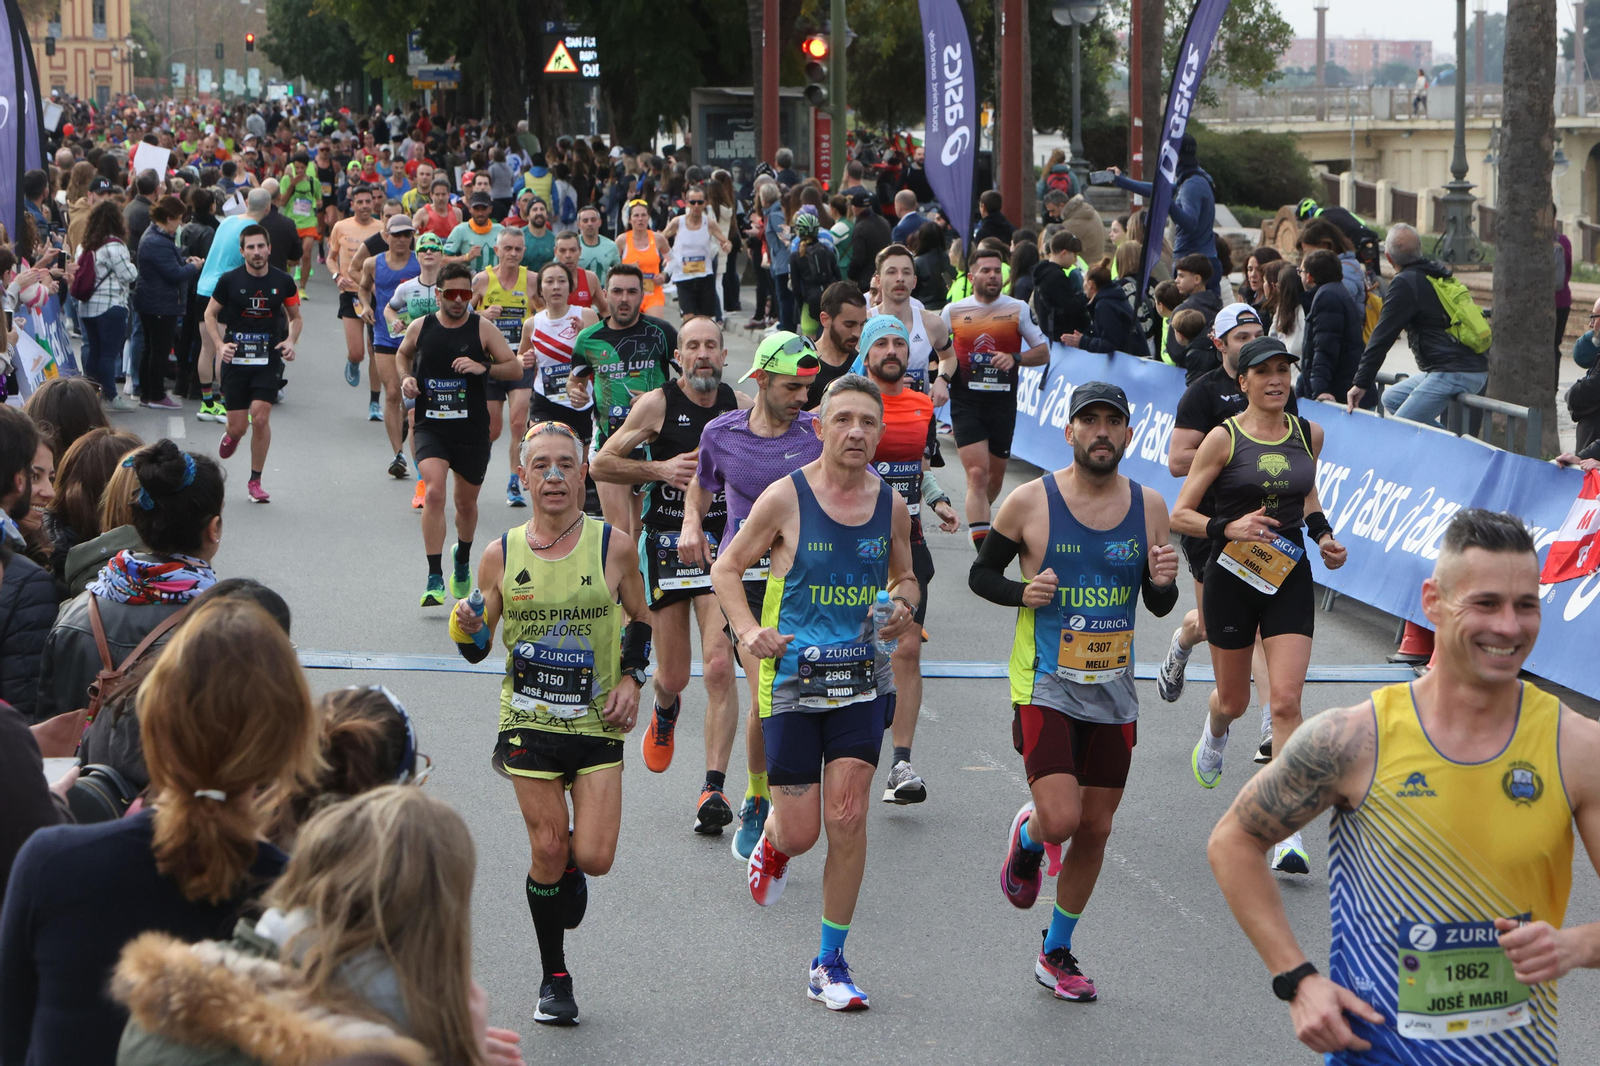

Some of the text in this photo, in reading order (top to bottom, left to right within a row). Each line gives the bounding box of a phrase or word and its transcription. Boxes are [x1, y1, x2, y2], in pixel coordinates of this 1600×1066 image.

[411, 298, 436, 308] CARBO
[554, 364, 572, 372] ZURIC
[628, 360, 655, 370] LUIS
[1141, 411, 1176, 466] asic
[893, 464, 919, 472] ZURICH
[892, 482, 909, 491] 3032
[1316, 459, 1350, 524] sics
[1352, 478, 1412, 544] asics
[1402, 497, 1462, 560] asic
[808, 542, 832, 551] GOBIK
[1056, 544, 1081, 553] GOBIK
[1273, 539, 1296, 555] RICH
[1251, 545, 1273, 564] 5962
[1244, 559, 1262, 574] AMAL
[508, 606, 609, 621] AMIGOS PIRÁMIDE
[1090, 619, 1128, 629] ZURICH
[826, 647, 866, 658] ZURICH
[1087, 642, 1111, 652] 4307
[540, 650, 584, 663] ZURICH
[1086, 660, 1109, 668] MELLI
[537, 672, 564, 686] 3150
[521, 686, 581, 703] JOSÉ ANTONIO
[827, 687, 853, 697] FINIDI
[529, 883, 559, 896] HANKER
[1445, 928, 1501, 943] ZURIC
[1445, 962, 1490, 982] 1862
[1427, 990, 1508, 1012] JOSÉ MARI
